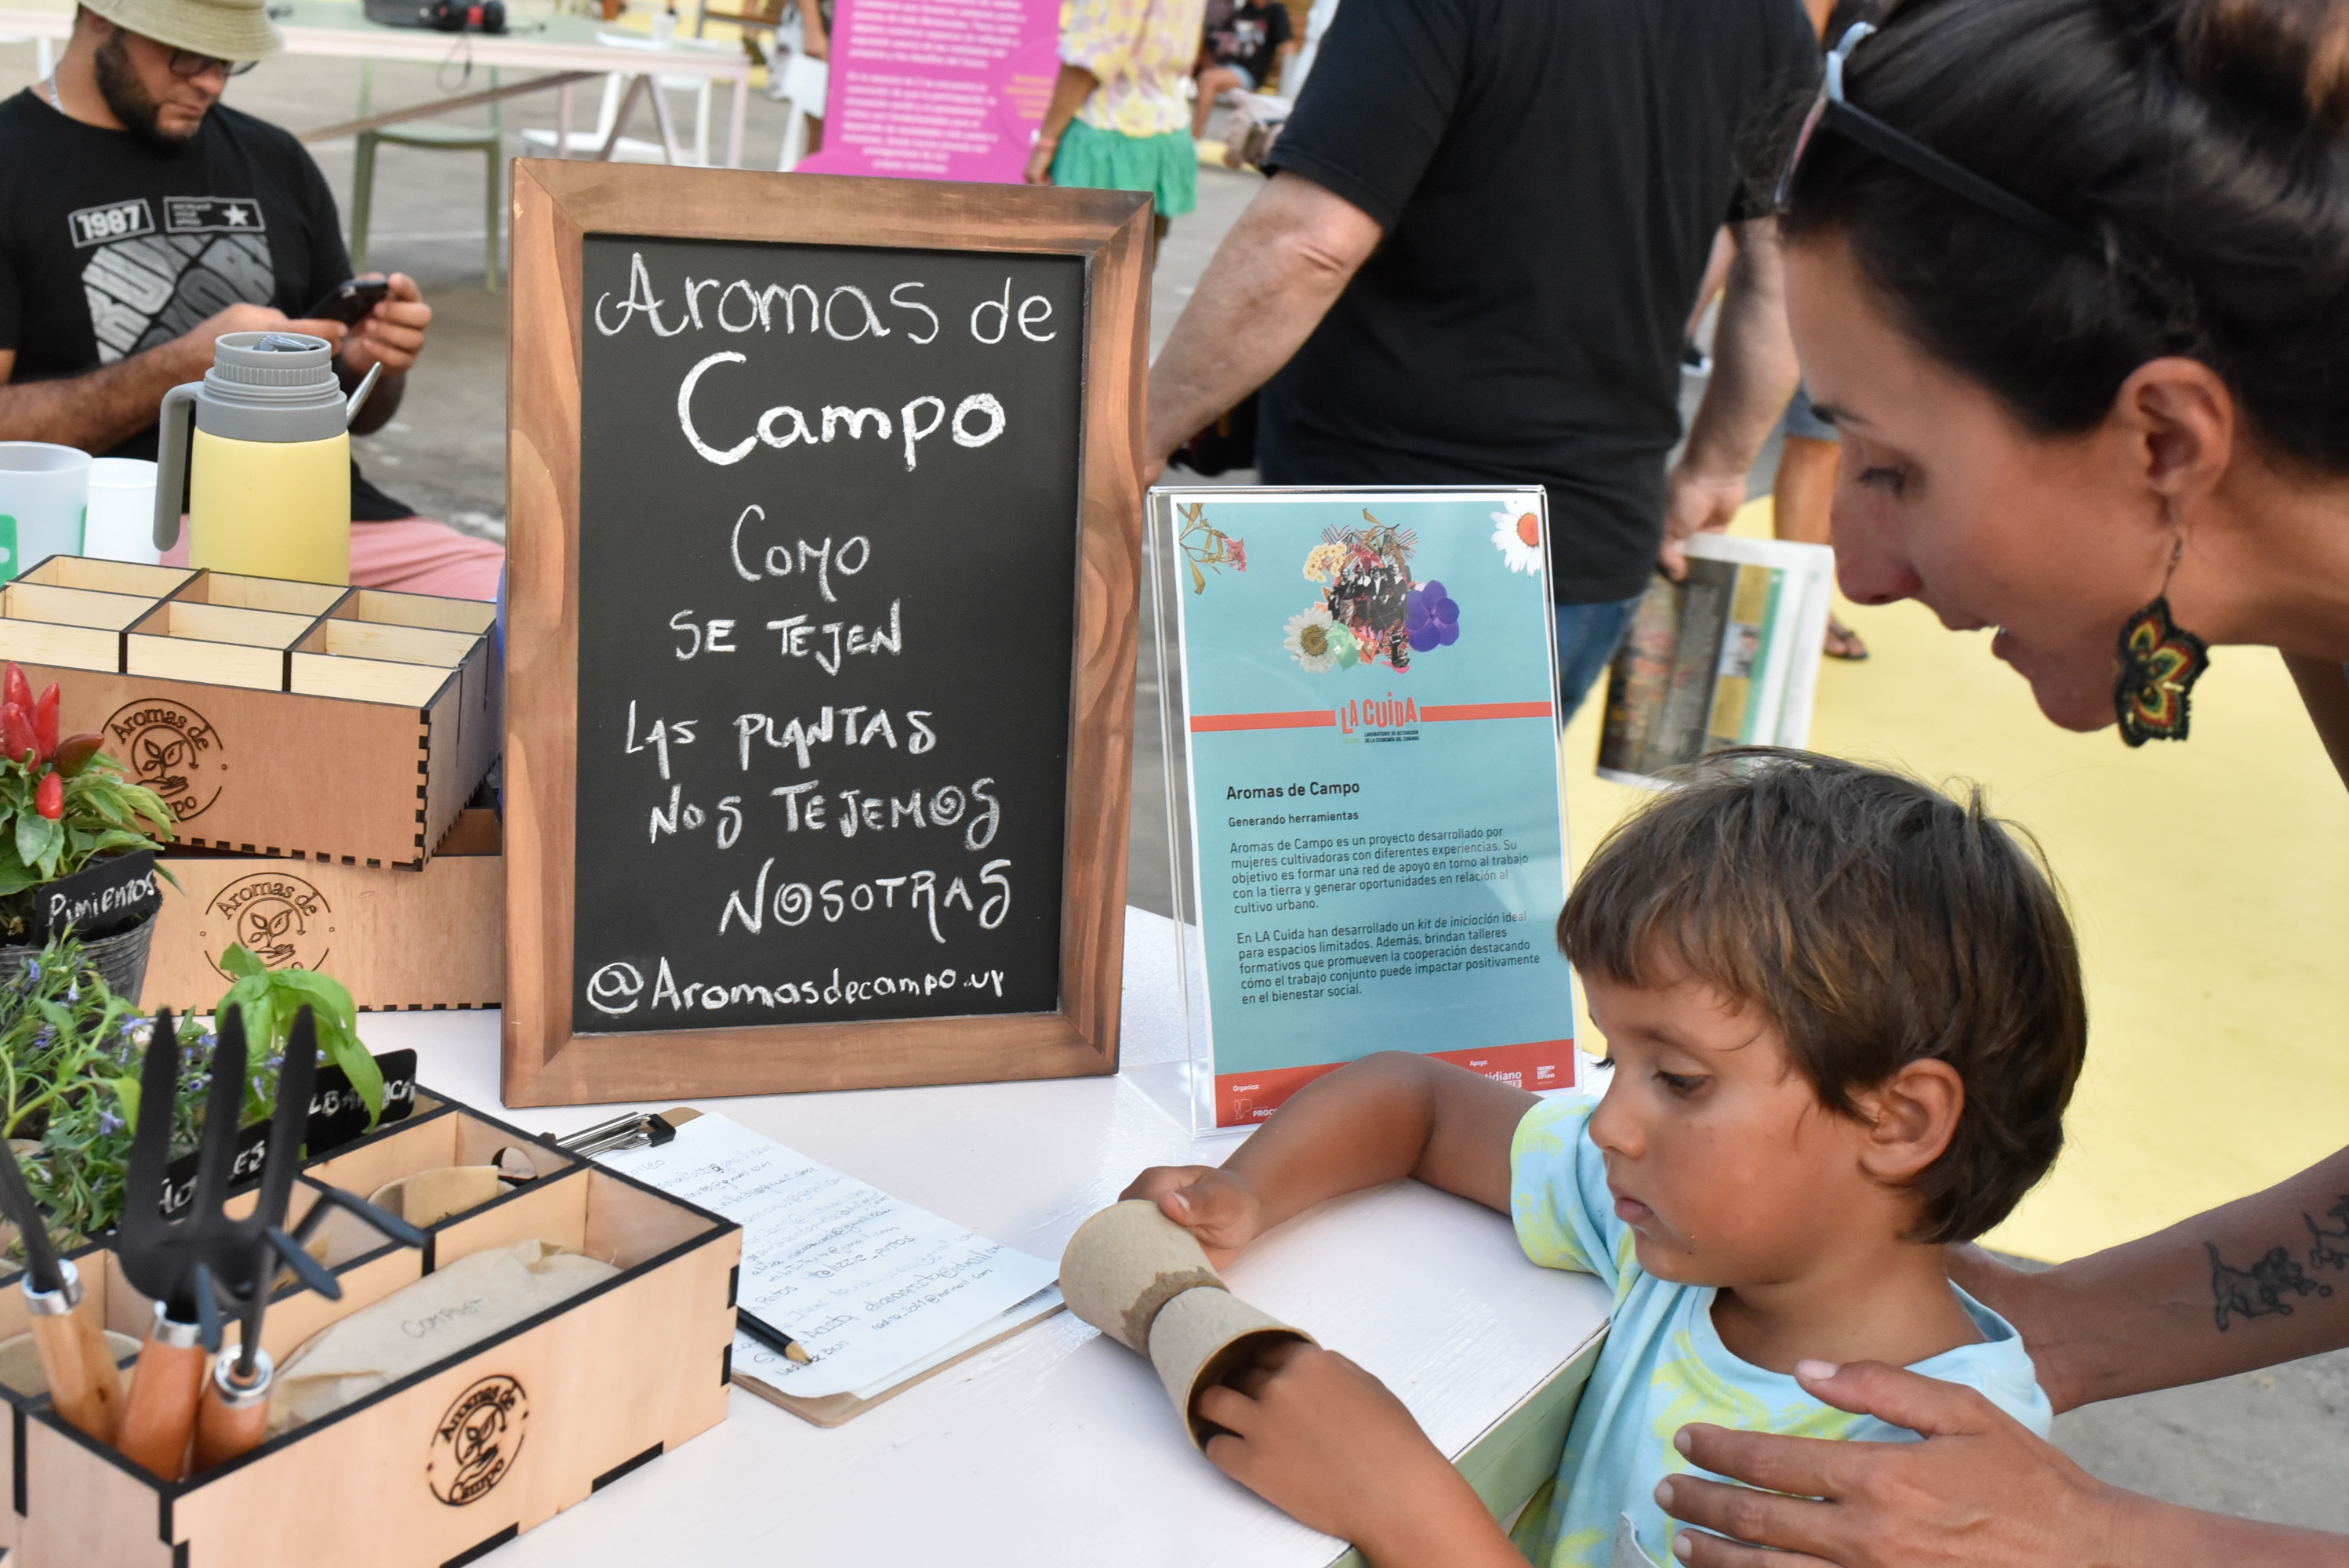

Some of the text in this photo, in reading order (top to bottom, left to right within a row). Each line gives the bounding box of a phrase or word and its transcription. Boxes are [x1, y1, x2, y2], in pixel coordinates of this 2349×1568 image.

[77, 205, 140, 240] 1987
[595, 252, 1056, 344] Aromas de
[677, 350, 1006, 472] Campo
[670, 598, 901, 676] SE TEJEN
[111, 708, 210, 751] Aromas de
[1341, 699, 1360, 734] LA
[1226, 782, 1360, 800] Aromas de Campo
[771, 777, 1000, 851] TEJEMOS
[1228, 811, 1359, 827] Generando herramientas
[1229, 827, 1503, 853] Aromas de Campo es un proyecto desarrollado por
[1231, 840, 1517, 870] mujeres cultivadoras con diferentes experiencias. Su
[1232, 853, 1529, 886] objetivo es formar una red de apoyo en torno al trabajo
[1233, 869, 1509, 898] con la tierra y generar oportunidades en relación al
[216, 881, 317, 920] Aromas de
[717, 857, 1011, 943] NOSOTRAS
[1234, 898, 1319, 913] cultivo urbano.
[1236, 910, 1527, 944] En LA Cuida han desarrollado un kit de iniciación ideal
[1238, 928, 1508, 962] para espacios limitados. Además, brindan talleres
[1239, 940, 1530, 974] formativos que promueven la cooperación destacando
[1240, 955, 1540, 989] cómo el trabajo conjunto puede impactar positivamente
[1242, 984, 1362, 1004] en el bienestar social.
[441, 1383, 517, 1443] Aromas de
[449, 1458, 505, 1506] Campo
